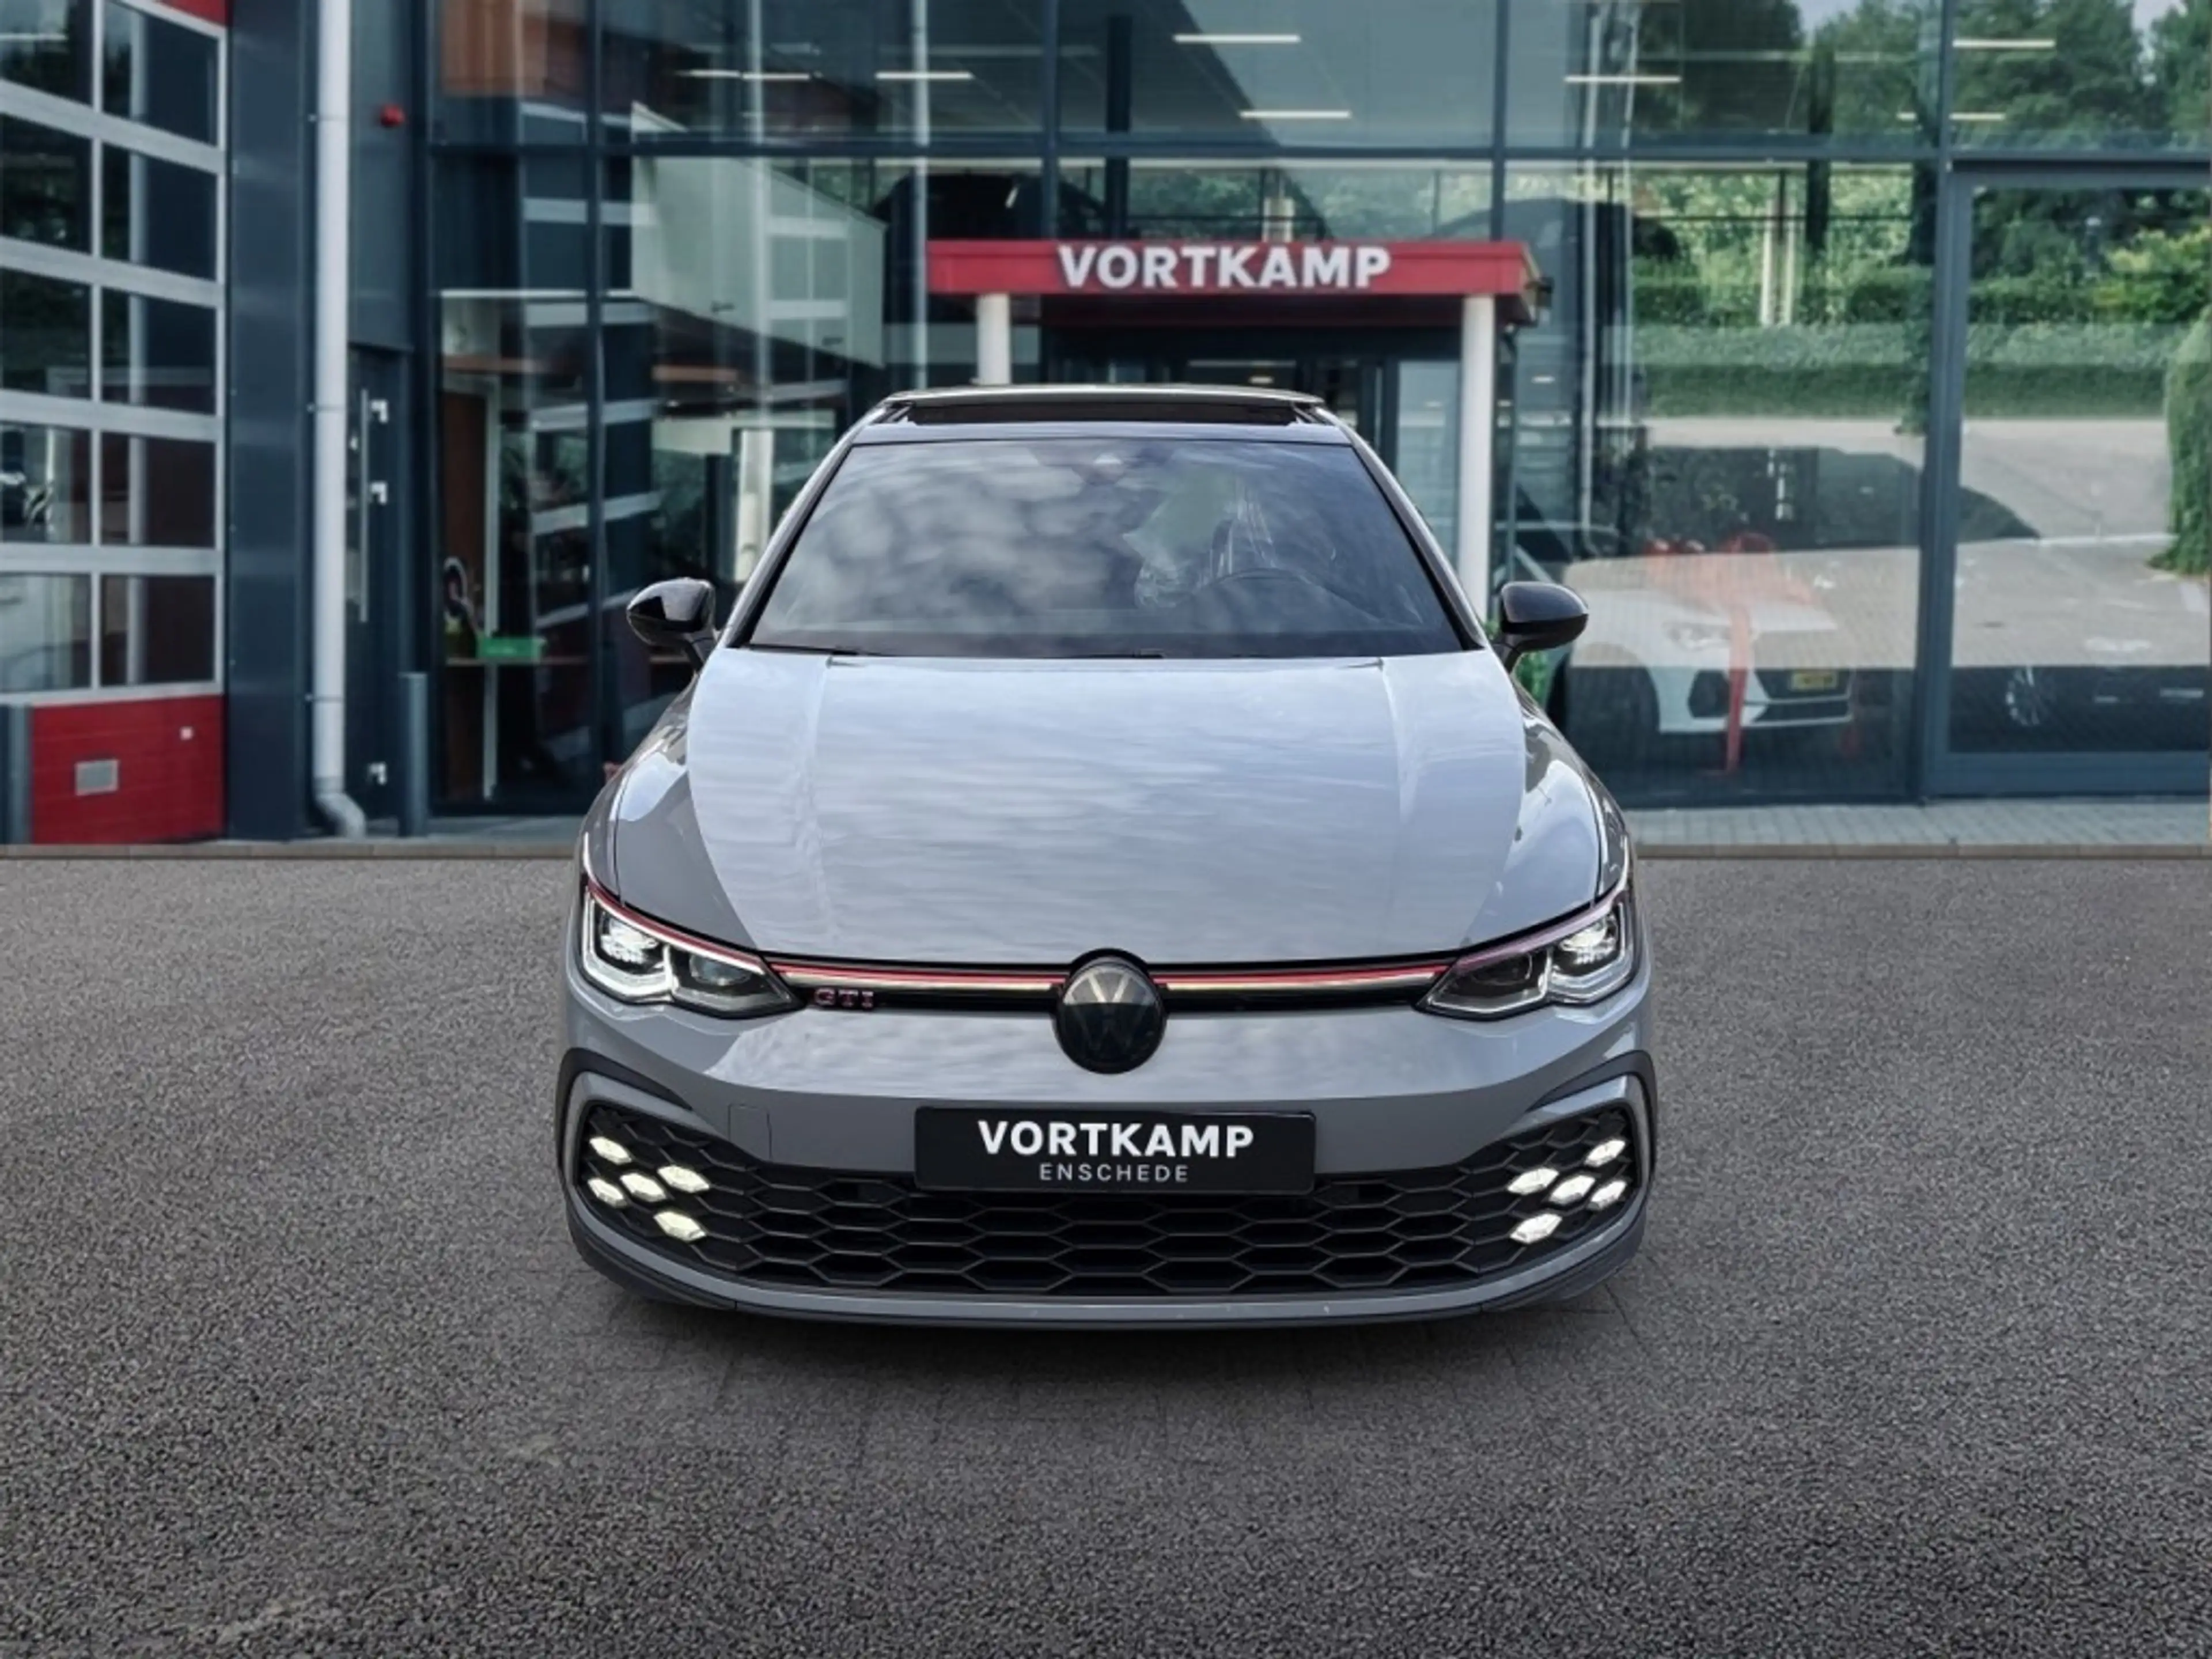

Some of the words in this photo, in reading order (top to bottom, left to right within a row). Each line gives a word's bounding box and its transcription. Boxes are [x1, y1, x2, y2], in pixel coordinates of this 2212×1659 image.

[1058, 245, 1391, 288] VORTKAMP
[814, 987, 874, 1009] GTI
[978, 1120, 1254, 1158] VORTKAMP
[1039, 1162, 1188, 1182] ENSCHEDE
